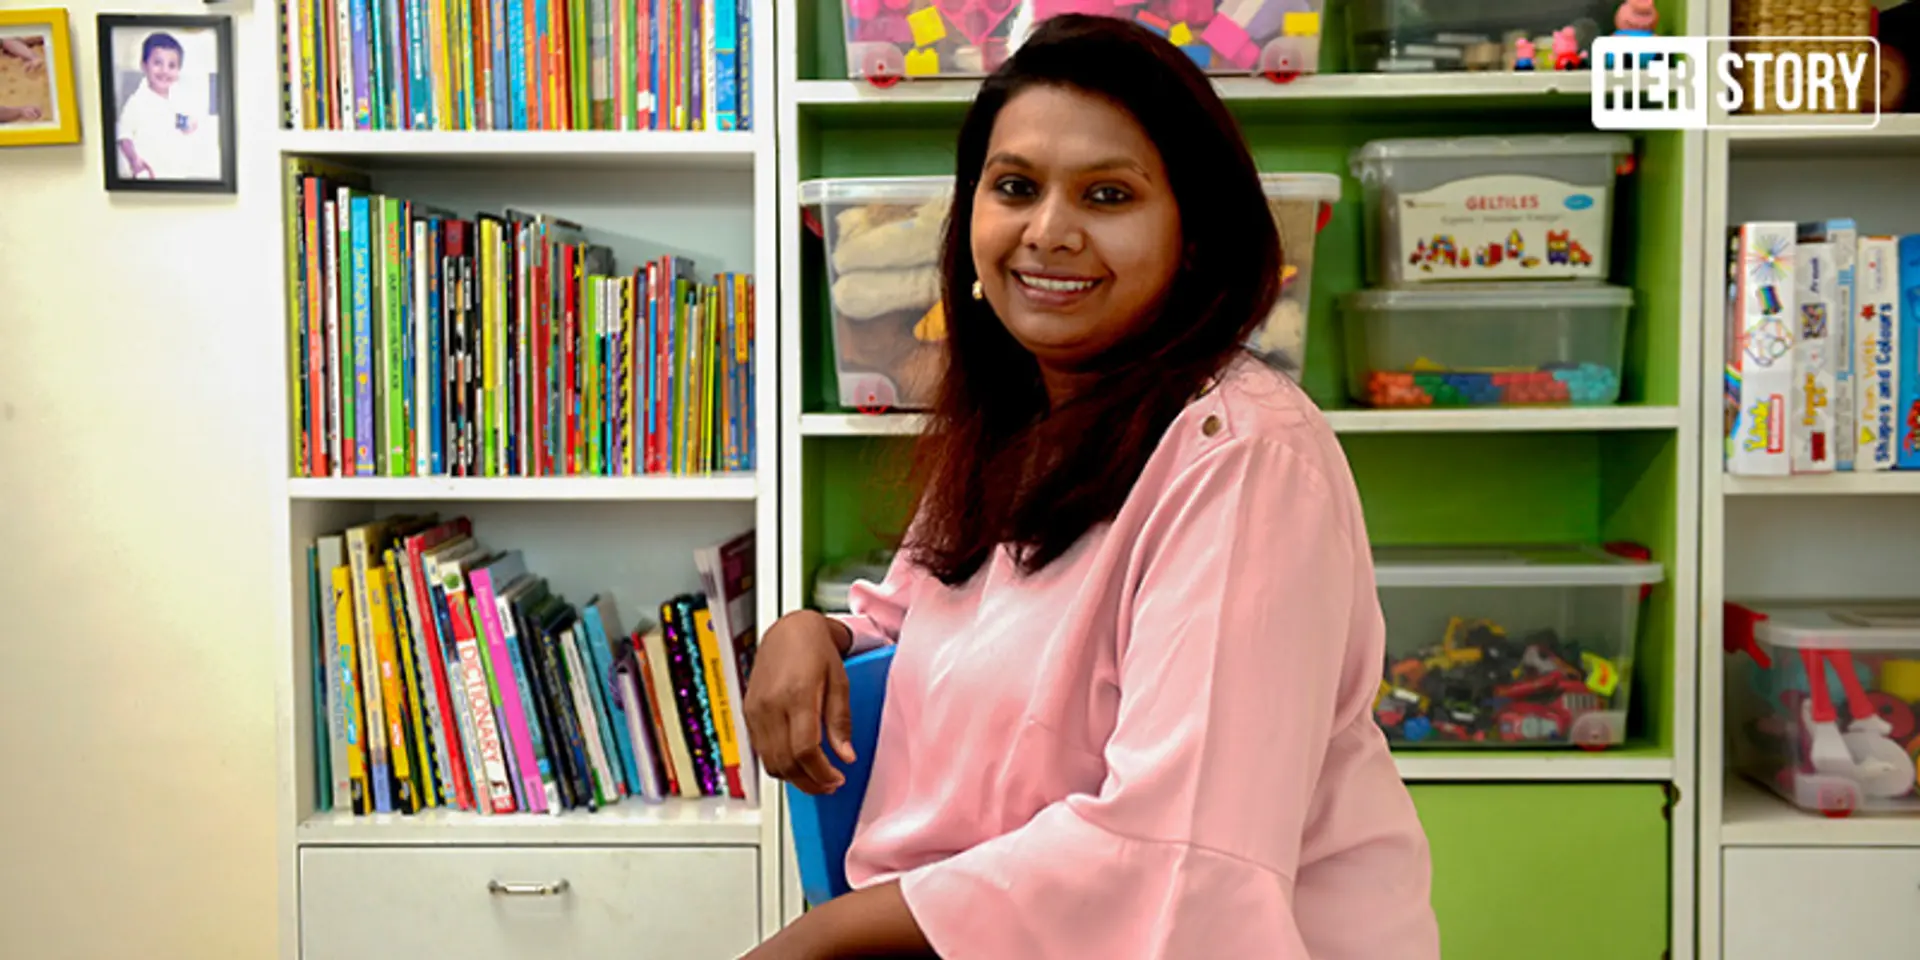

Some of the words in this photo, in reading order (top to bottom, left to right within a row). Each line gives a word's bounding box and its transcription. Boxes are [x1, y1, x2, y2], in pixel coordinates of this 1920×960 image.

[1876, 303, 1893, 364] Colours
[1879, 370, 1892, 399] and
[1874, 405, 1893, 463] Shapes
[459, 643, 500, 762] DICTIONARY
